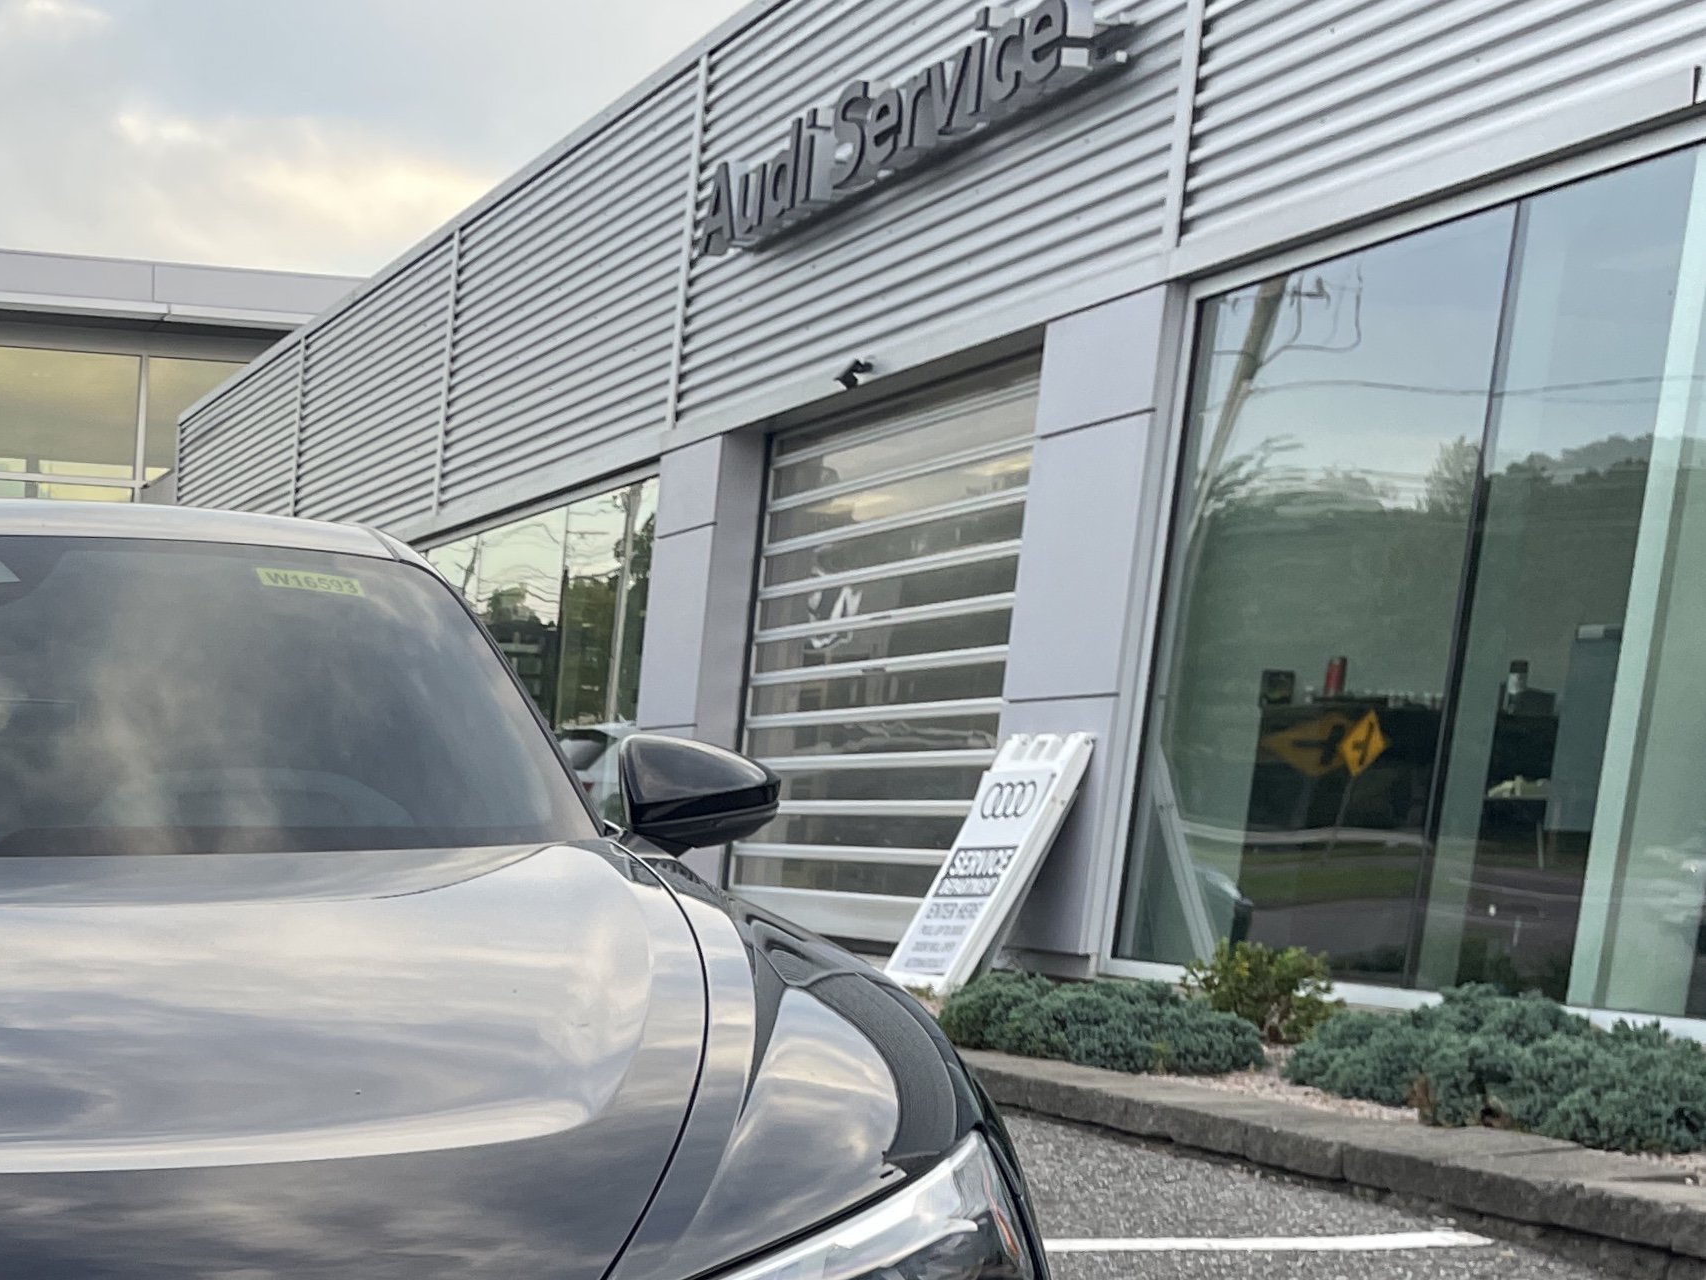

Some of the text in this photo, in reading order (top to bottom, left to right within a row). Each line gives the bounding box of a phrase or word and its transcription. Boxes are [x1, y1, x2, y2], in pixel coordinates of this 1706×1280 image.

[702, 0, 1082, 256] Audi Service
[265, 571, 359, 594] W16593
[949, 849, 1015, 876] SERVICE
